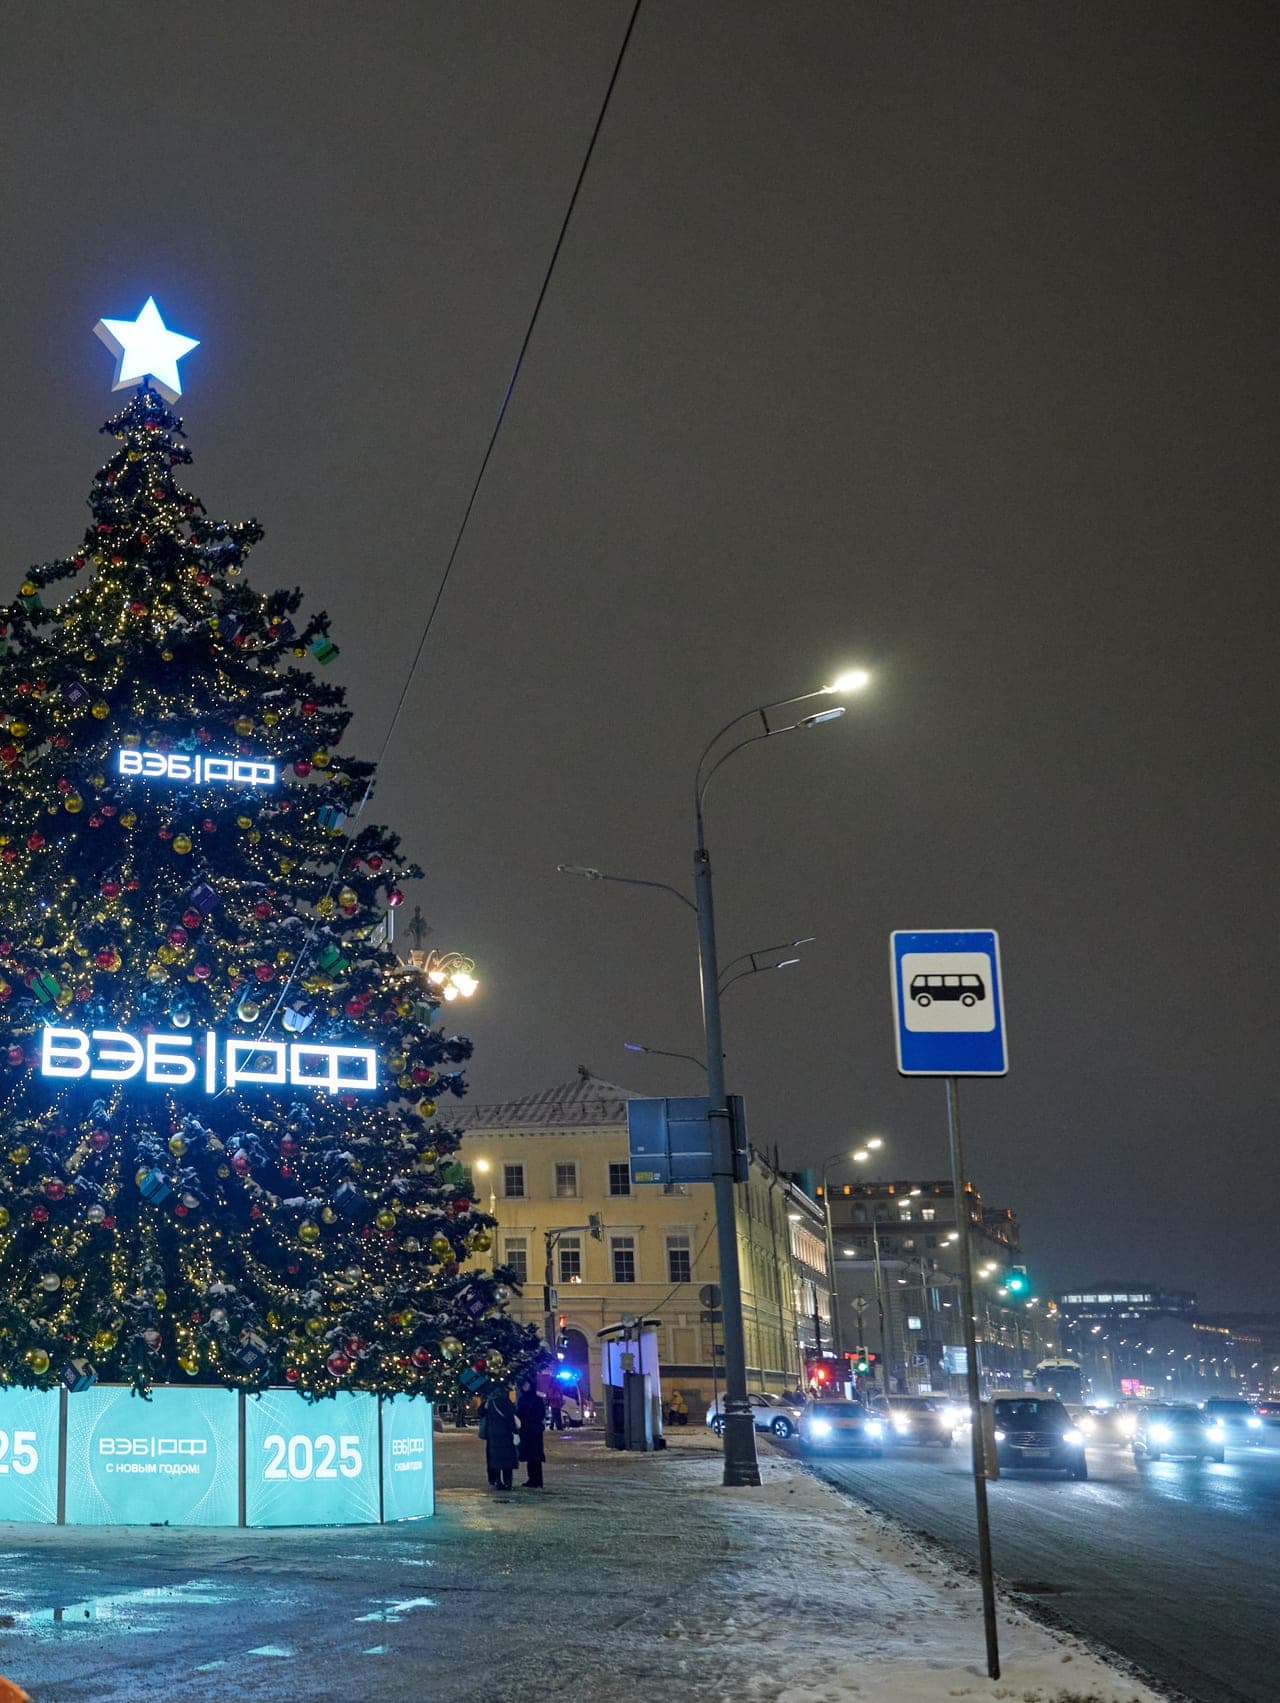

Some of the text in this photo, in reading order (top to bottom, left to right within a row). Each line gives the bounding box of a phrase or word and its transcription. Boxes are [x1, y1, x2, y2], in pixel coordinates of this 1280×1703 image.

[106, 1463, 200, 1475] С НОВЫМ ГОДОМ!
[263, 1434, 362, 1478] 2025
